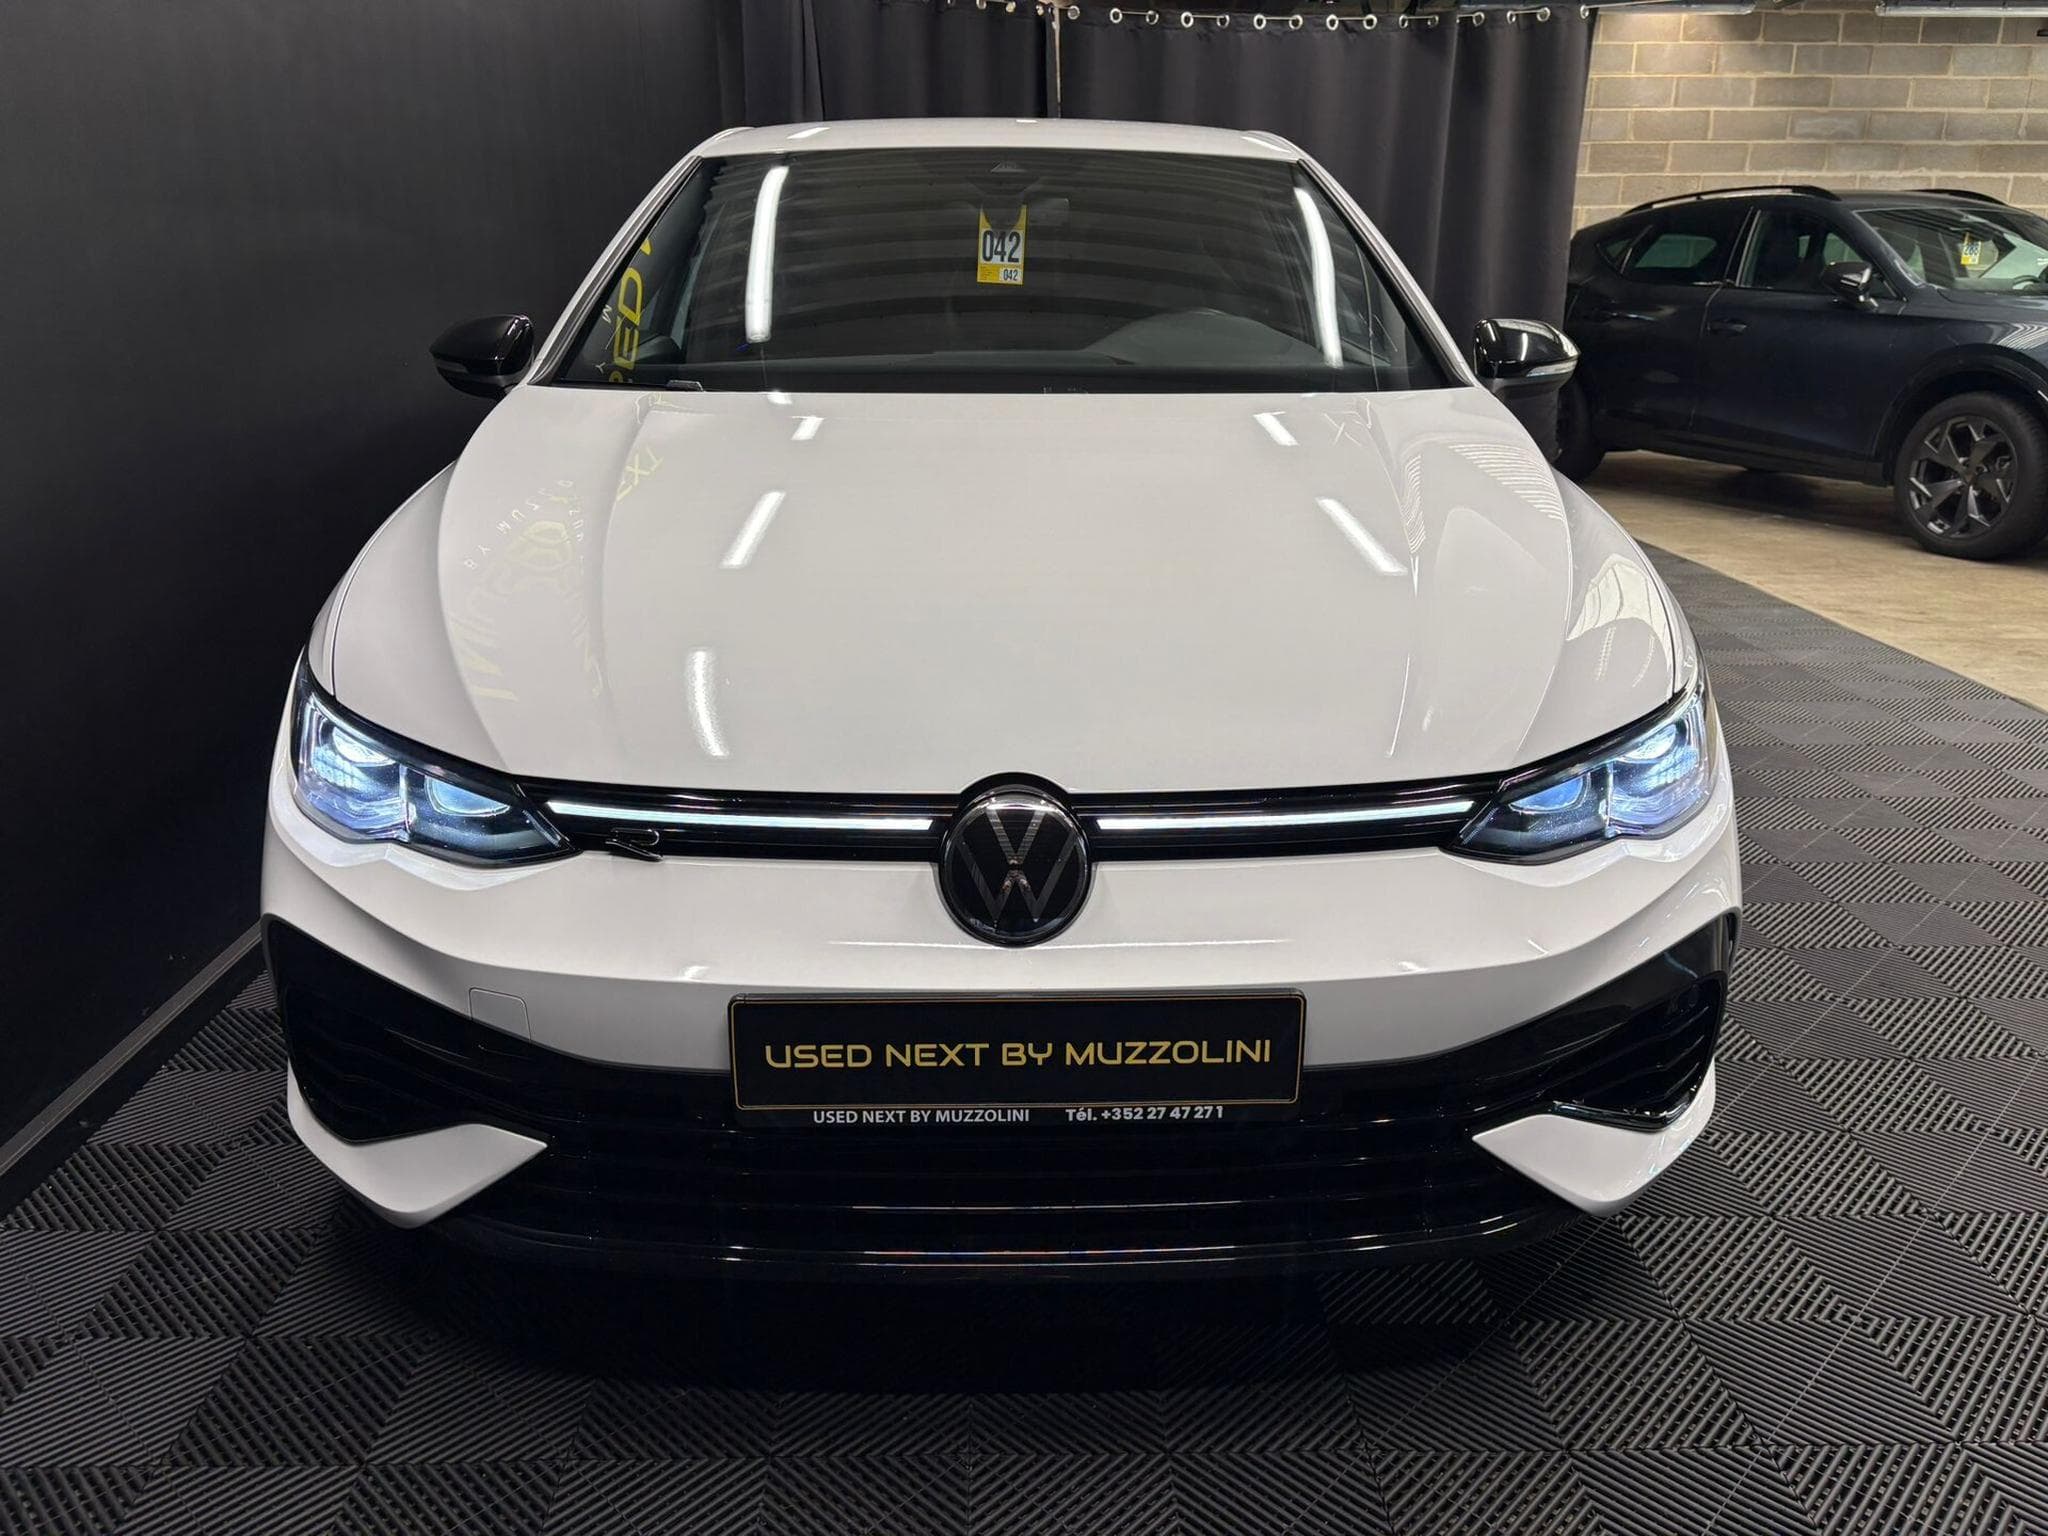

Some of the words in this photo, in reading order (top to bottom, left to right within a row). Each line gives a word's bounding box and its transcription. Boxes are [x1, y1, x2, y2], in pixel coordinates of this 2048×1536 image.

[982, 230, 1021, 262] 042
[1003, 269, 1018, 280] 042
[765, 1045, 872, 1068] USED
[886, 1043, 989, 1067] NEXT
[1002, 1042, 1053, 1066] BY
[1065, 1040, 1271, 1065] MUZZOLINI
[813, 1111, 858, 1124] USED
[862, 1110, 907, 1123] NEXT
[910, 1110, 932, 1123] BY
[935, 1109, 1030, 1123] MUZZOLINI
[1065, 1107, 1098, 1121] Tél.
[1101, 1107, 1143, 1121] +352
[1147, 1107, 1165, 1119] 27
[1169, 1107, 1189, 1119] 47
